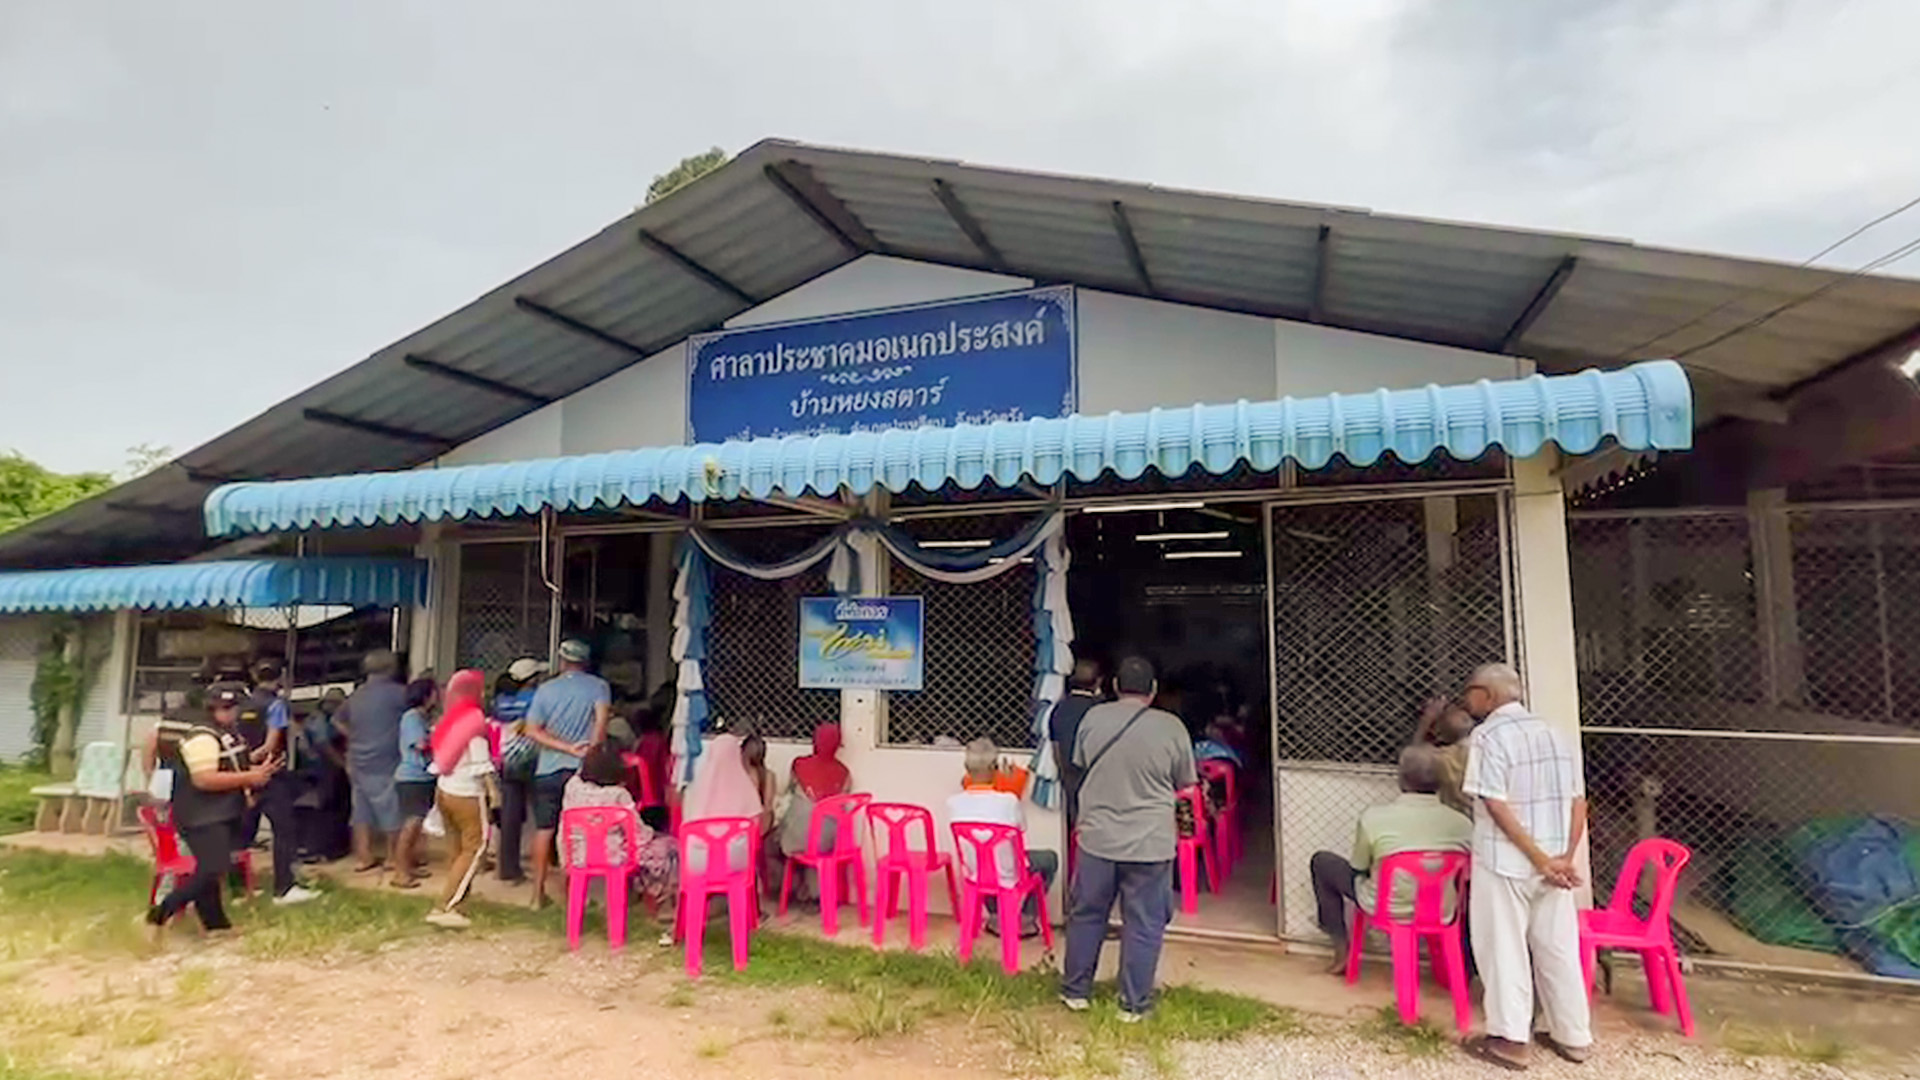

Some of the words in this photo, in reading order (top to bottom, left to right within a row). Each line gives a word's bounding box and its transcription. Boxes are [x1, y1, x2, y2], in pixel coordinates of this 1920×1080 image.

[710, 306, 1046, 380] ศาลาประชาคมอเนกประสงค์
[790, 377, 949, 417] บ้านหยงสตาร์
